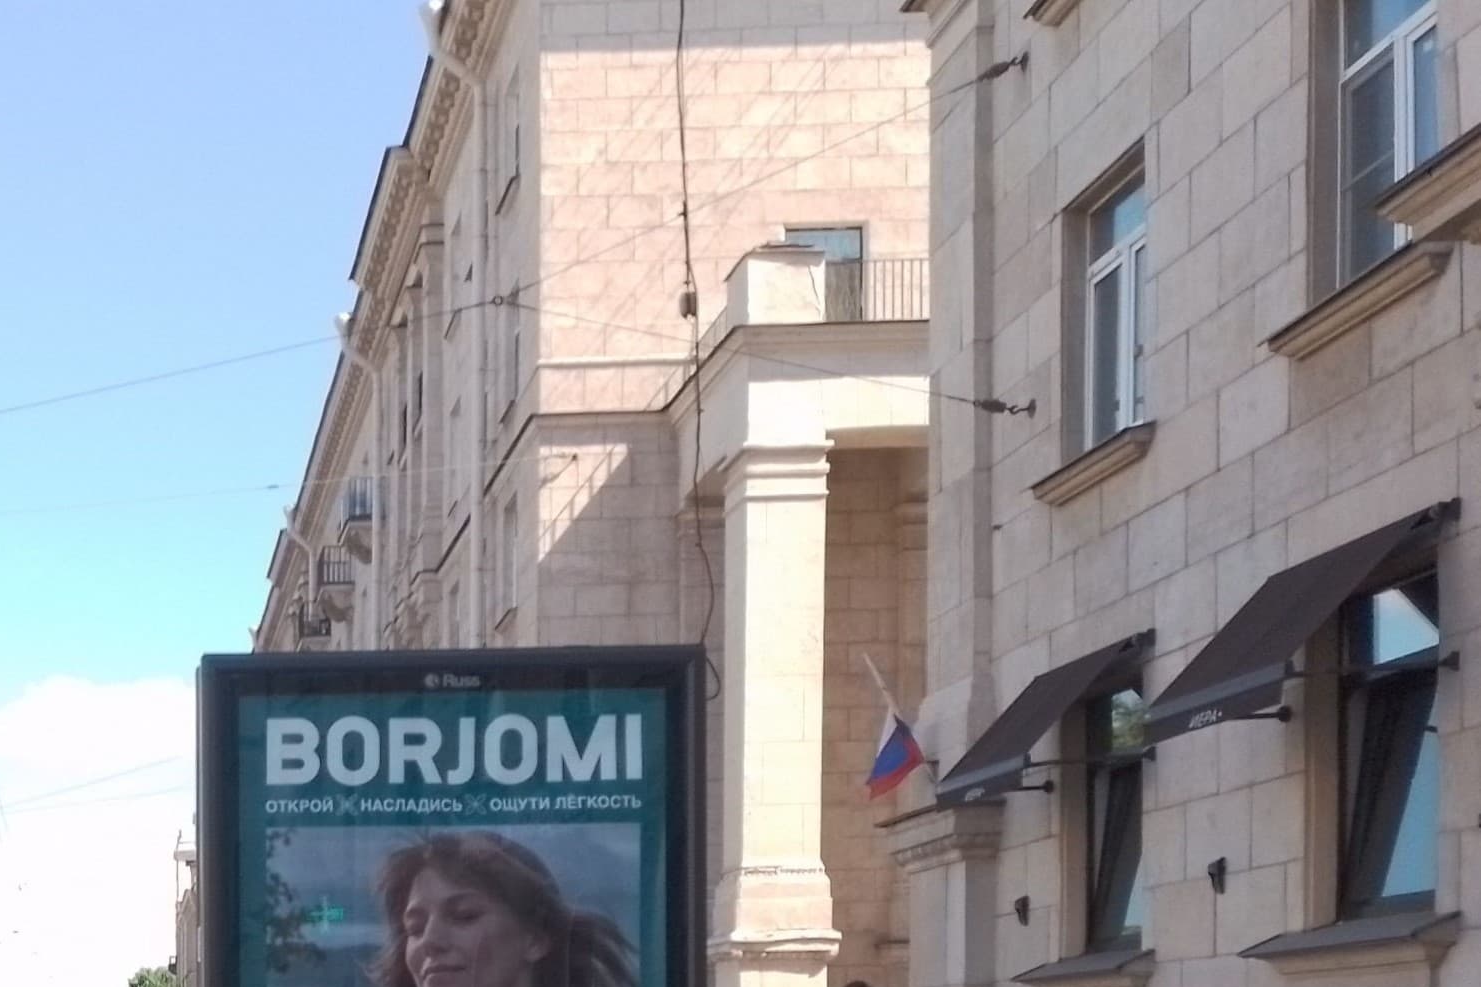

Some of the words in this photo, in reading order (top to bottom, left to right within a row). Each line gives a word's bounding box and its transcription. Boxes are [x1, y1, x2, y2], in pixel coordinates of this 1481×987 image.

[265, 713, 643, 786] BORJOMI
[265, 796, 334, 814] ОТКРОЙ
[360, 797, 463, 814] НАСЛАДИСЬ
[489, 796, 551, 812] ОЩУТИ
